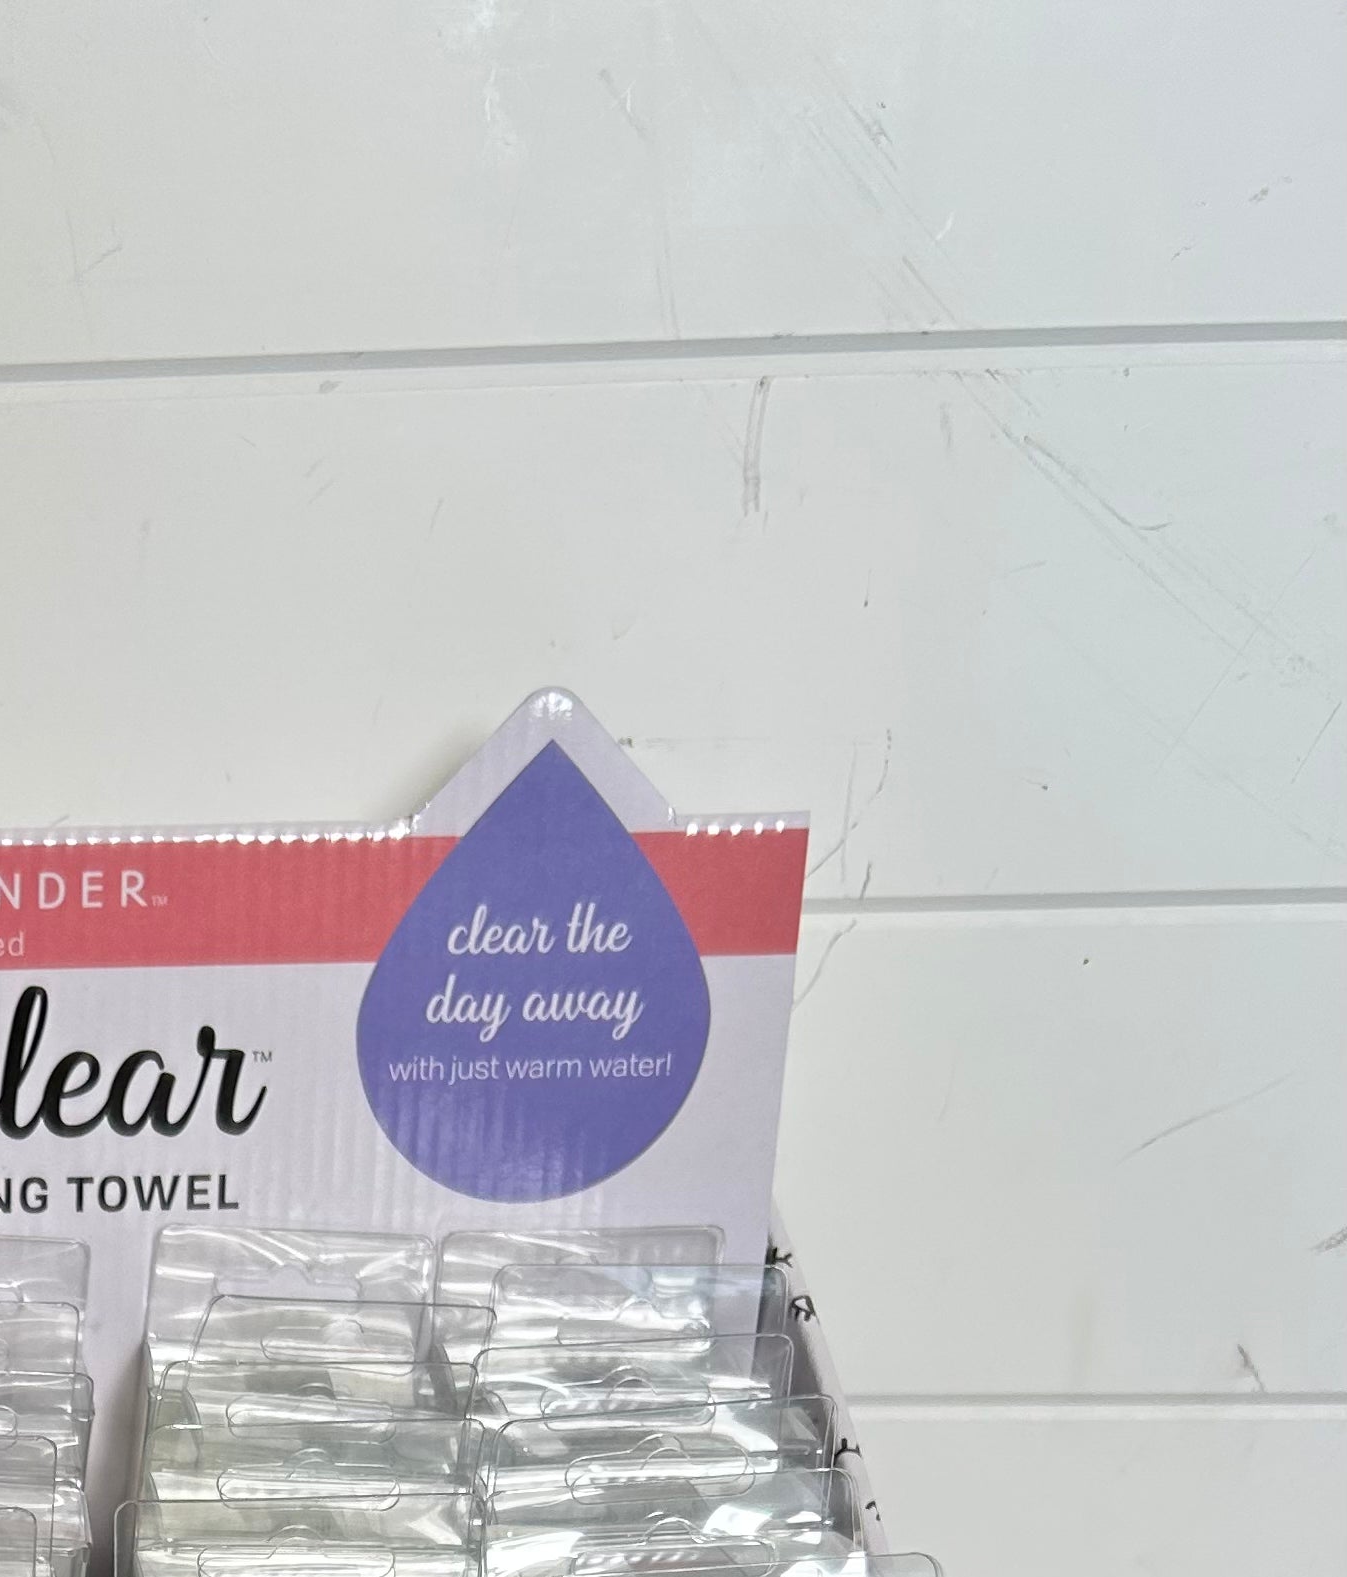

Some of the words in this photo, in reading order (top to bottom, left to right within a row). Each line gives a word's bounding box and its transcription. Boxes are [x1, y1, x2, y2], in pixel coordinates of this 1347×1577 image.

[448, 904, 554, 955] clear
[566, 902, 633, 952] the
[426, 974, 512, 1043] day
[523, 986, 645, 1041] away
[389, 1057, 444, 1081] with
[448, 1057, 500, 1085] just
[506, 1058, 582, 1079] warm
[589, 1052, 672, 1078] water!
[66, 1173, 240, 1213] TOWEL
